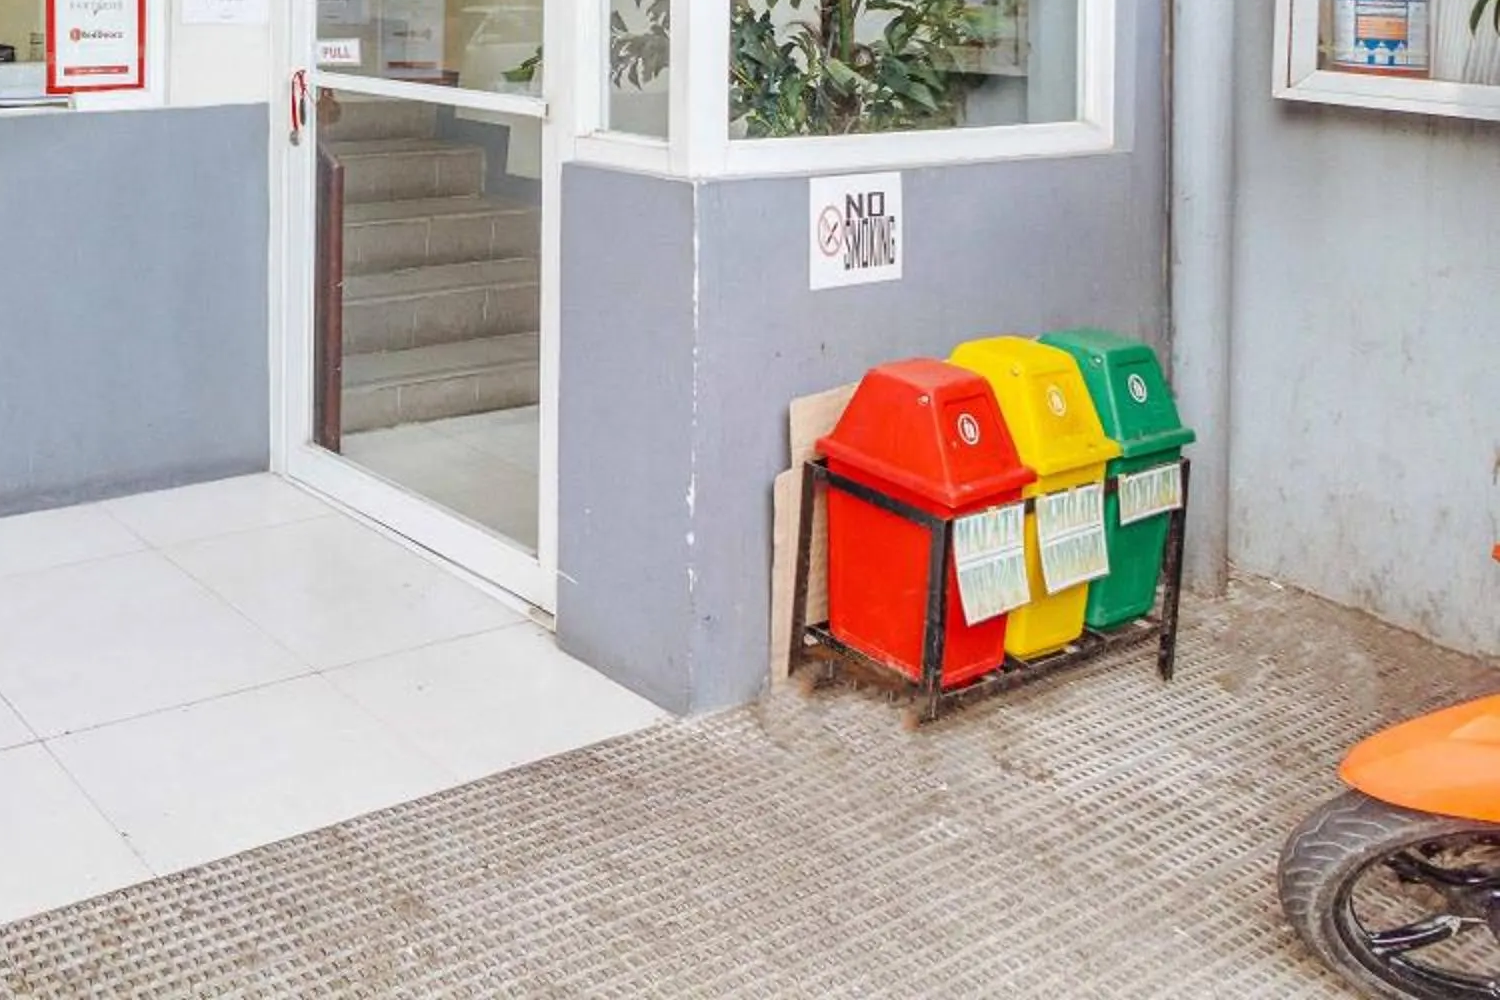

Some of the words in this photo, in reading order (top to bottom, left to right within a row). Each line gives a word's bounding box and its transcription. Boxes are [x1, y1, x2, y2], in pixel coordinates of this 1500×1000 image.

[323, 46, 351, 59] PULL
[845, 191, 885, 219] NO
[843, 216, 895, 270] SMOKING
